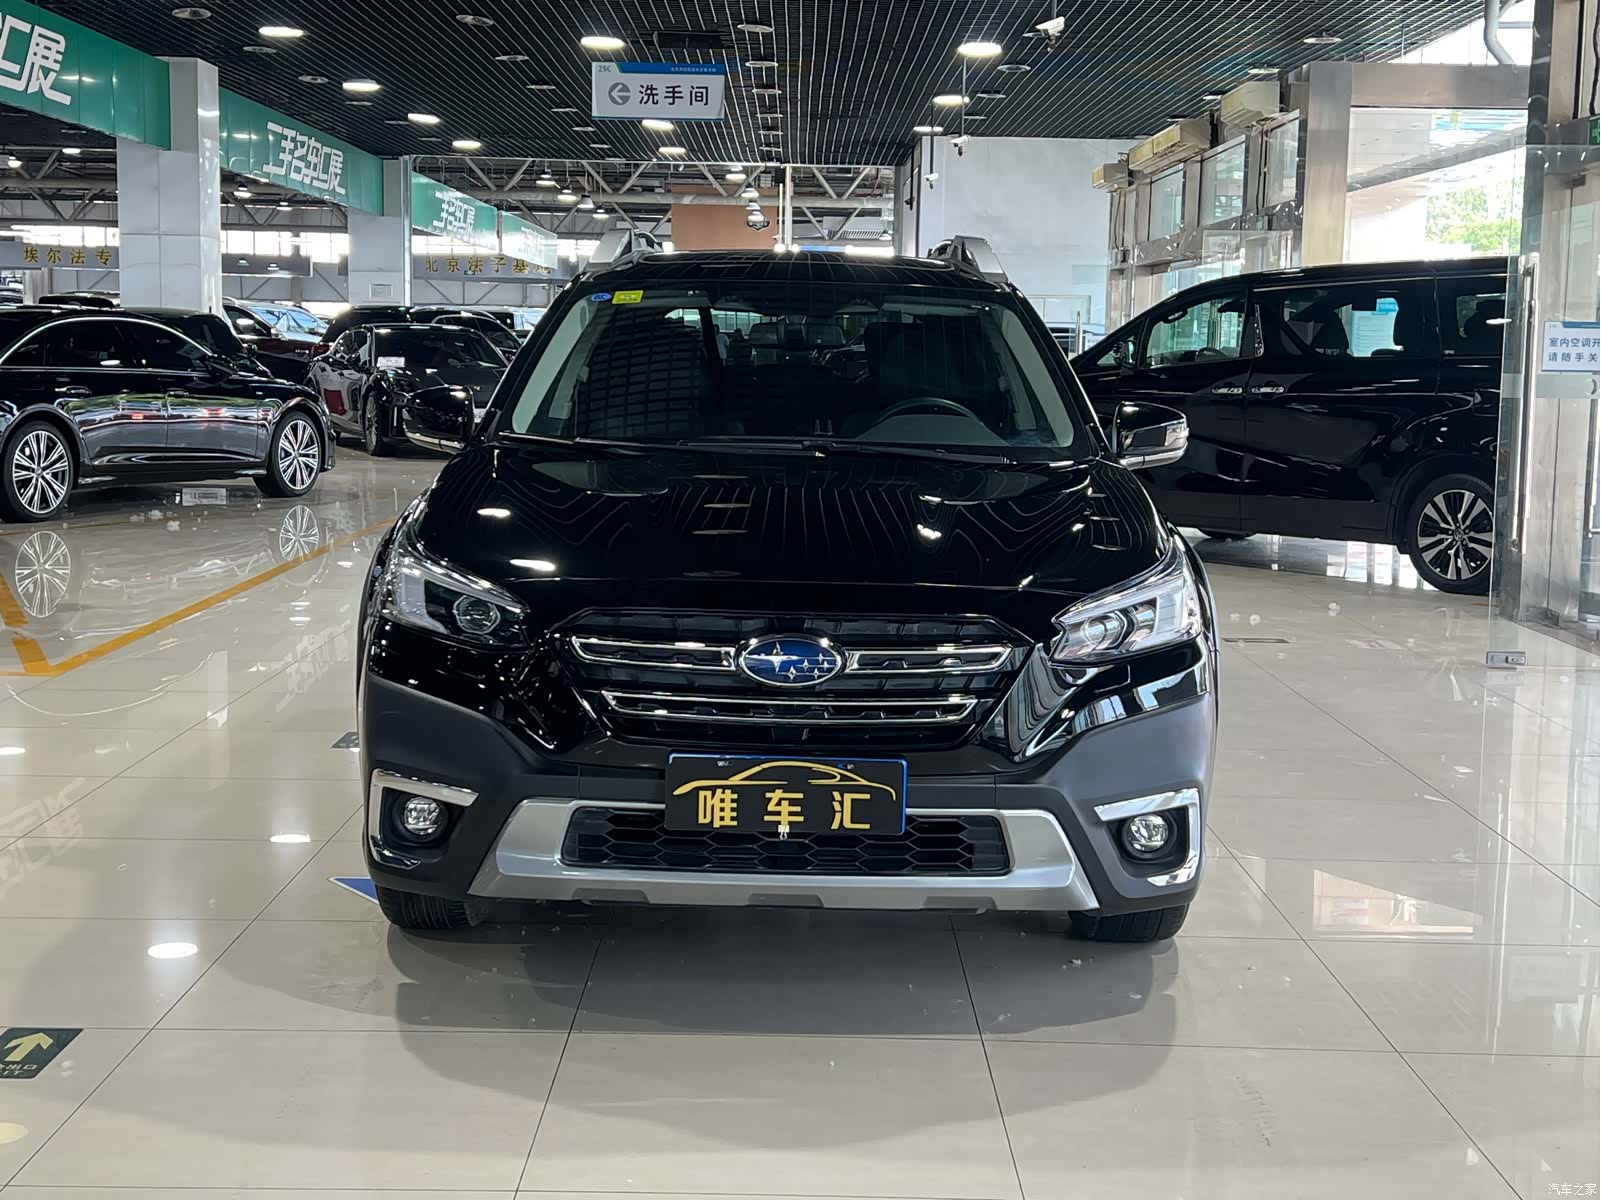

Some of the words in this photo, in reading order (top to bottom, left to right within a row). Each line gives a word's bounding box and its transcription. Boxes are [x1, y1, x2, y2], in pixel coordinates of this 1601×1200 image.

[638, 84, 709, 106] 洗手间
[263, 121, 346, 195] 二手名车汇展
[23, 246, 112, 266] 埃尔法专
[1549, 337, 1600, 348] 室内空调开
[1548, 352, 1598, 362] 请随手关
[697, 788, 871, 830] 唯车汇
